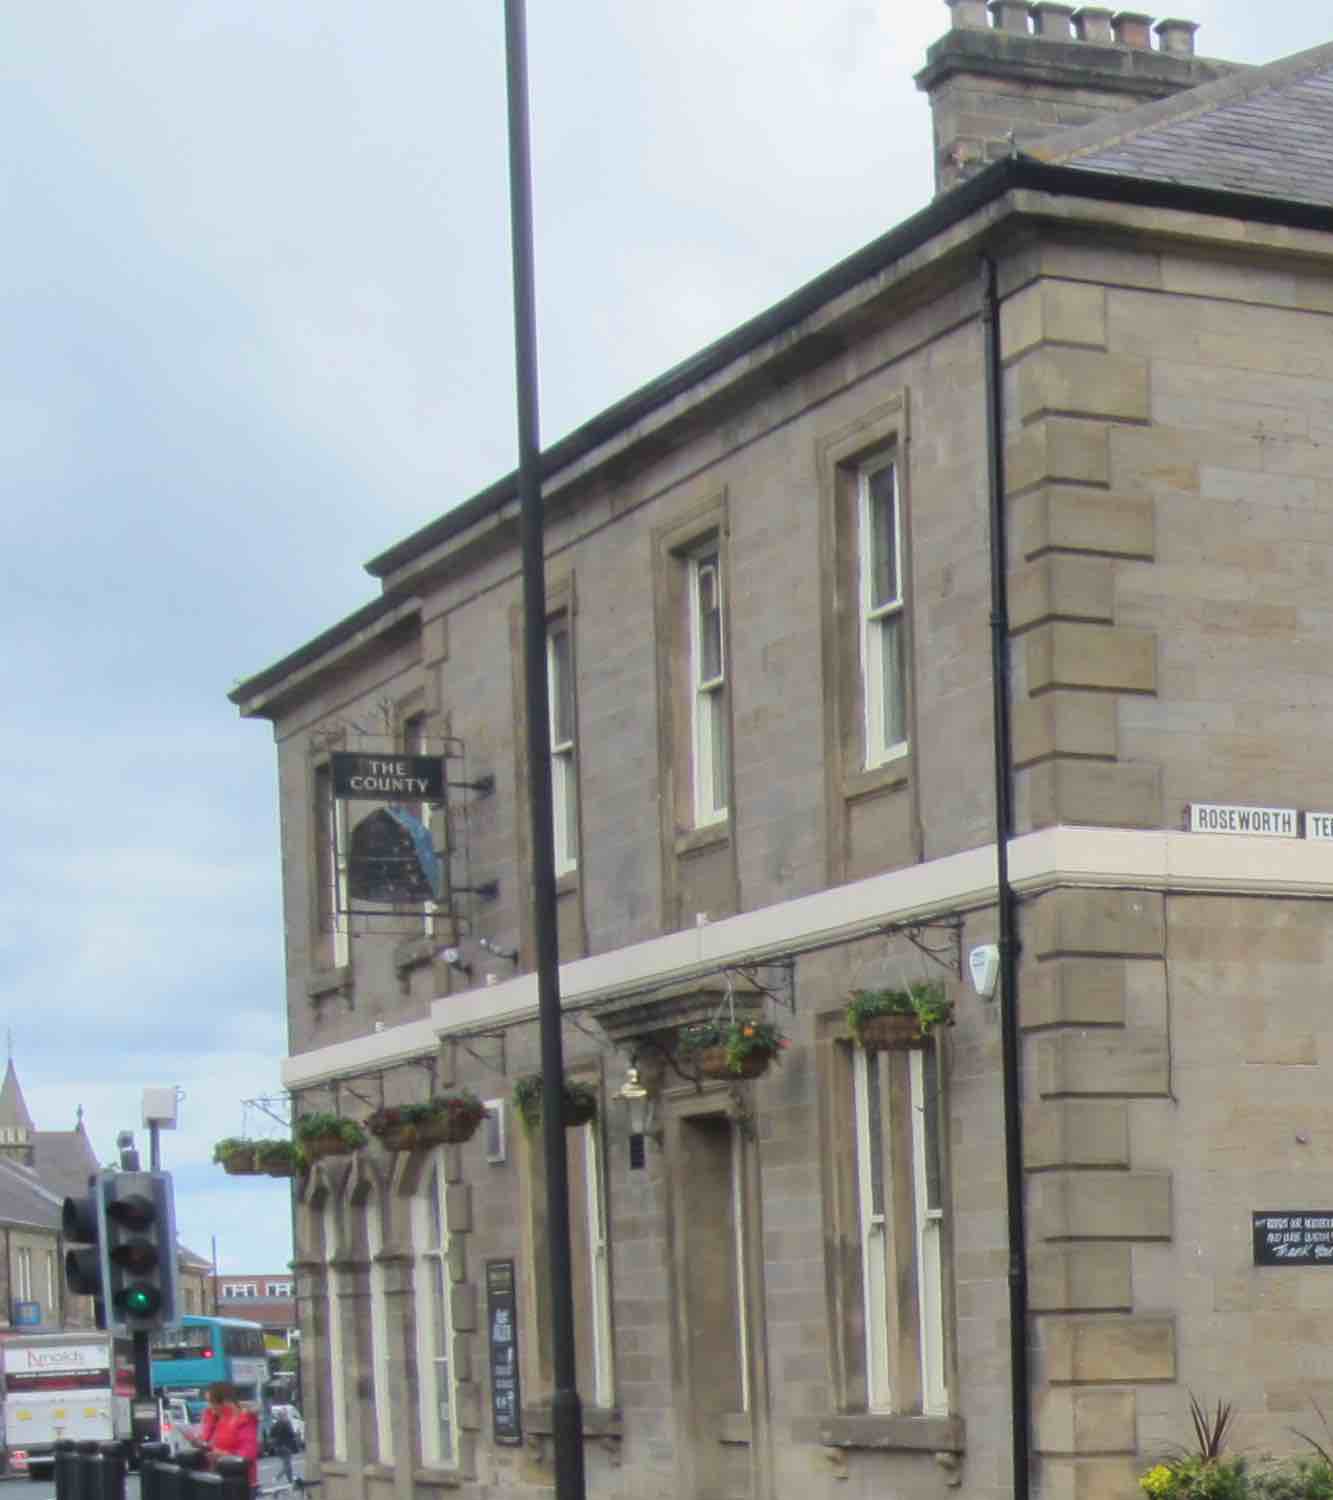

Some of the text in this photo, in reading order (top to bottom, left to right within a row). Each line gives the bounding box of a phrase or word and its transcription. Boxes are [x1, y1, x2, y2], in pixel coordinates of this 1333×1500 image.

[368, 760, 408, 776] THE
[350, 776, 429, 792] COUNTY
[1199, 807, 1292, 833] ROSEWORTH
